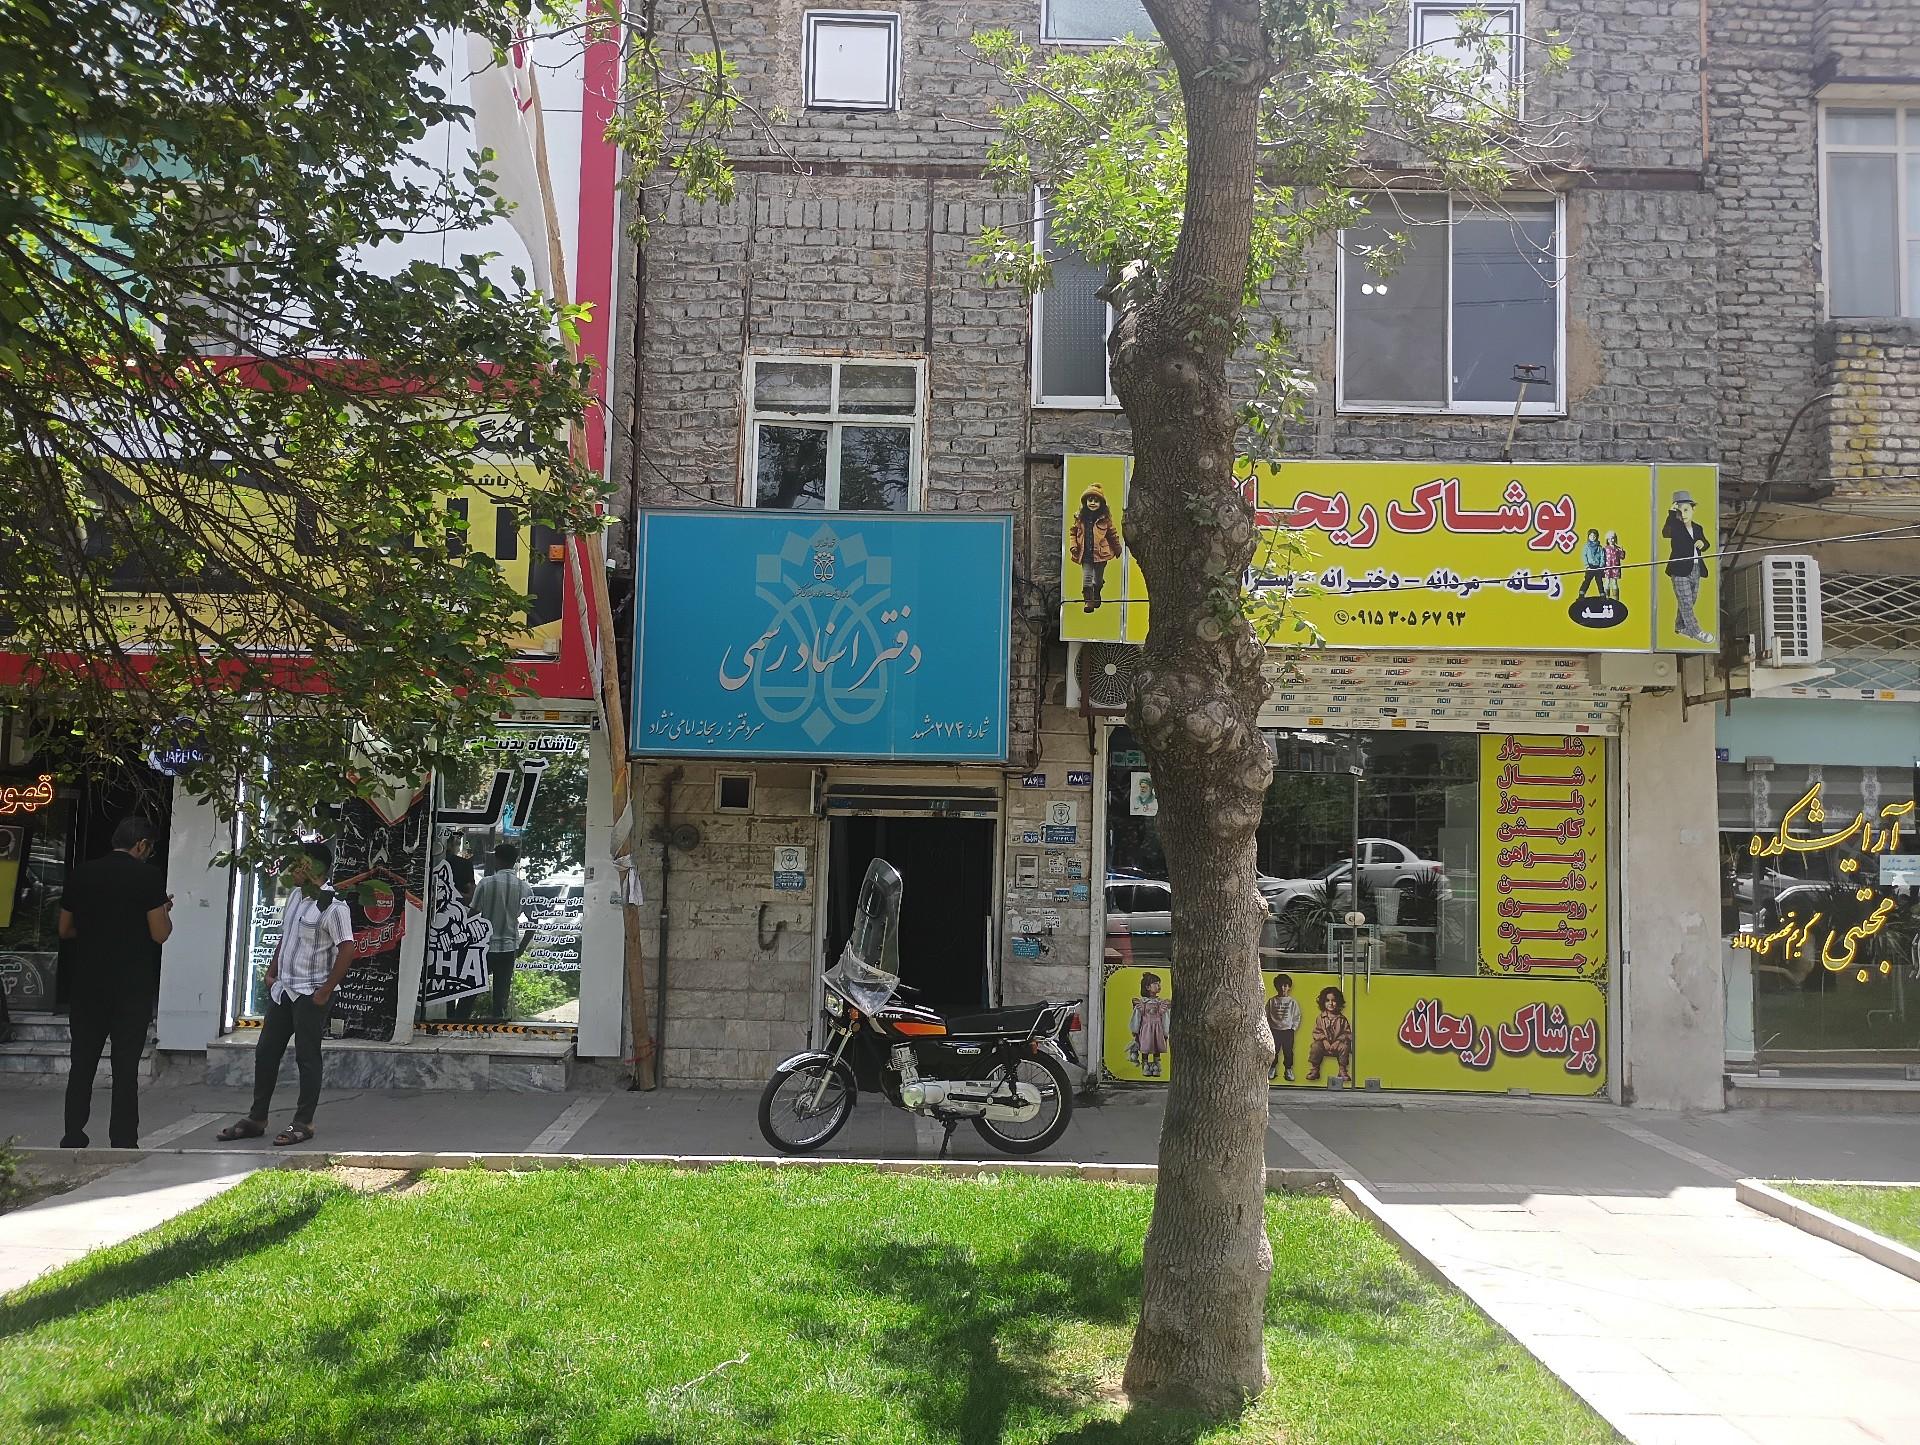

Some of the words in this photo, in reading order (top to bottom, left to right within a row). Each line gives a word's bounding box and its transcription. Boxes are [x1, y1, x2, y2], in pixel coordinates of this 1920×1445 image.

[1230, 475, 1380, 549] ریحا
[1387, 477, 1579, 554] پوشاک
[1242, 567, 1294, 598] پسرا
[1319, 568, 1400, 594] دخترانه
[1426, 569, 1481, 598] مردانه
[1505, 571, 1562, 598] زنانه
[1350, 610, 1384, 626] ۰۹۱۵
[1388, 609, 1417, 626] ۳۰۵
[1420, 609, 1442, 626] ۶۷
[1446, 609, 1466, 626] ۹۳
[1581, 604, 1614, 619] نقد
[719, 625, 788, 691] رسمی
[793, 624, 860, 673] اسناد
[848, 605, 922, 692] دفتر
[648, 709, 674, 736] نژاد
[668, 719, 695, 741] امامی
[695, 719, 724, 744] ریحانه
[911, 714, 935, 740] مشهد
[935, 721, 964, 739] ۲۷۴
[528, 734, 578, 756] باشگاه
[1497, 735, 1585, 760] شلوار
[1497, 764, 1585, 789] شال
[0, 774, 53, 814] قهو
[1497, 790, 1585, 815] بلوز
[1497, 817, 1585, 844] کاپشن
[1749, 782, 1914, 872] آرایشکده
[1497, 843, 1586, 870] پیراهن
[1497, 870, 1586, 894] دامن
[1498, 898, 1587, 919] روسری
[358, 922, 395, 953] آقایان
[1498, 920, 1587, 945] سوشرت
[1822, 887, 1895, 983] مجتبی
[1498, 946, 1587, 973] جوراب
[1400, 999, 1493, 1066] ریحانه
[1499, 1002, 1598, 1072] پوشاک
